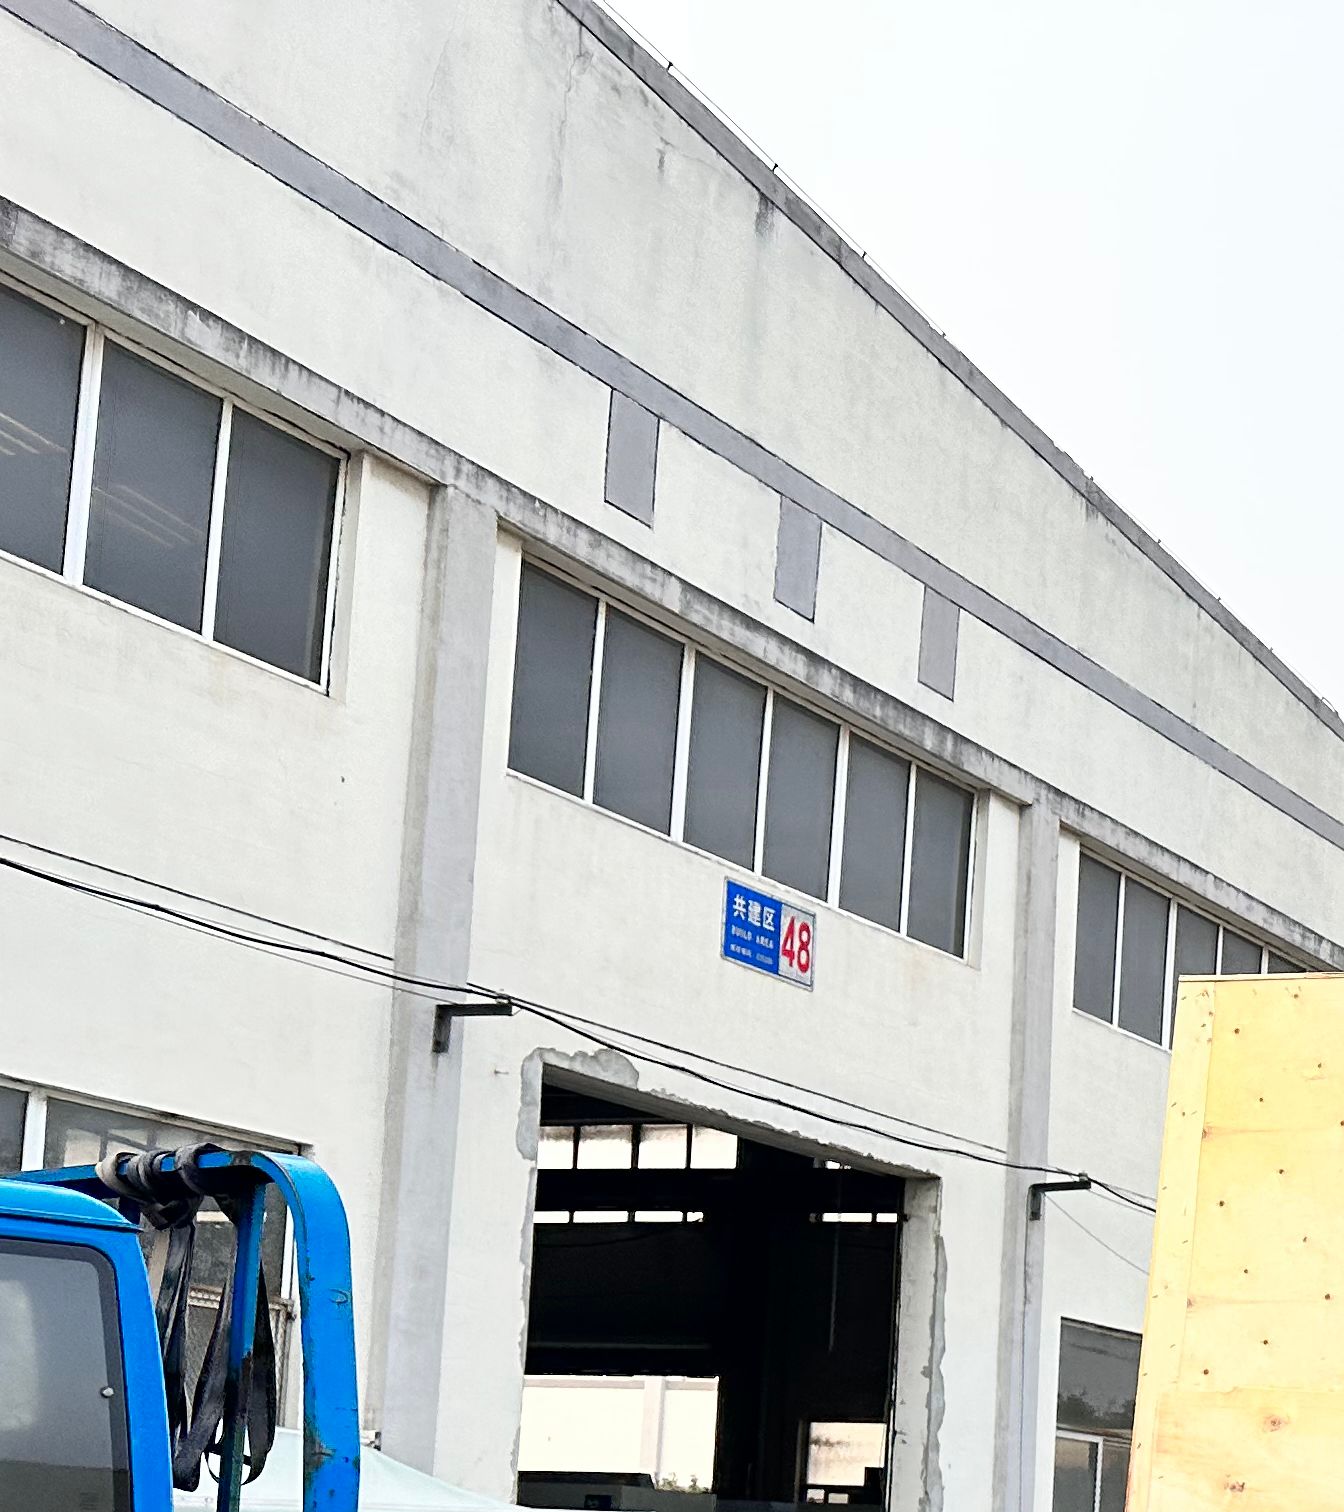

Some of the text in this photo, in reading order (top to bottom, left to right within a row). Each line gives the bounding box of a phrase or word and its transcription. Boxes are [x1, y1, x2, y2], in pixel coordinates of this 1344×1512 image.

[733, 893, 776, 931] 共建区
[781, 915, 812, 974] 48
